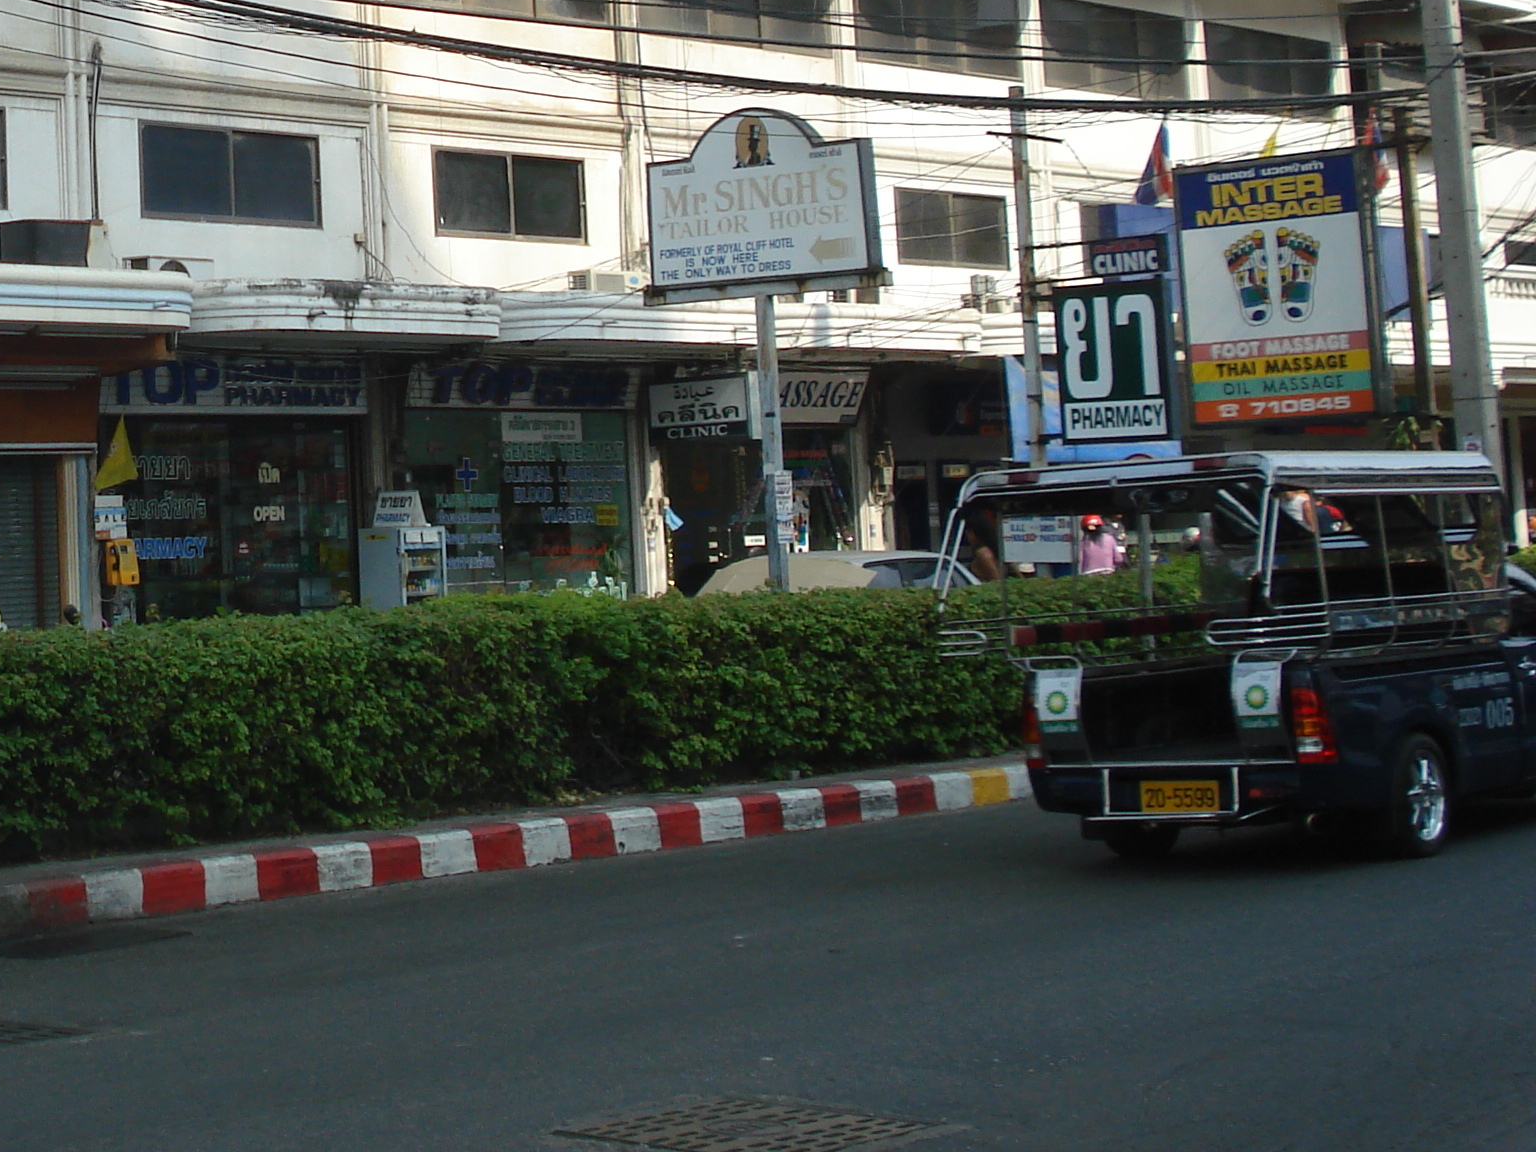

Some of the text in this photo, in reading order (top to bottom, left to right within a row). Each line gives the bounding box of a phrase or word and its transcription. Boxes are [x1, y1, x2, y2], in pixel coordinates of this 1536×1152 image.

[661, 165, 849, 219] Mr. SINGH'S
[1212, 172, 1325, 208] INTER
[658, 204, 848, 239] TAILOR HOUSE
[1196, 195, 1344, 227] MASSAGE
[660, 237, 794, 259] FORMERLY OF ROYAL CLIFF HOTEL
[685, 252, 759, 268] IS NOW HERE
[661, 260, 792, 280] THE ONLY WAY TO DRESS
[1093, 249, 1159, 275] CLINIC
[1063, 293, 1161, 399] ยา
[1211, 334, 1350, 360] FOOT MASSAGE
[1216, 354, 1348, 378] THAI MASSAGE
[430, 362, 535, 405] TOP
[779, 380, 864, 409] ASSAGE
[1223, 374, 1345, 396] OIL MASSAGE
[225, 385, 362, 407] PHARMACY
[1250, 395, 1351, 416] 710845
[1071, 404, 1163, 430] PHARMACY
[667, 424, 728, 440] CLINIC
[124, 490, 208, 520] ยเภสัชกร
[514, 486, 554, 503] BLOOD
[253, 506, 286, 522] OPEN
[376, 512, 411, 522] PHARMACY
[540, 506, 595, 523] VIAGRA
[133, 536, 208, 560] ARMACY
[1144, 787, 1215, 808] 20-5599
